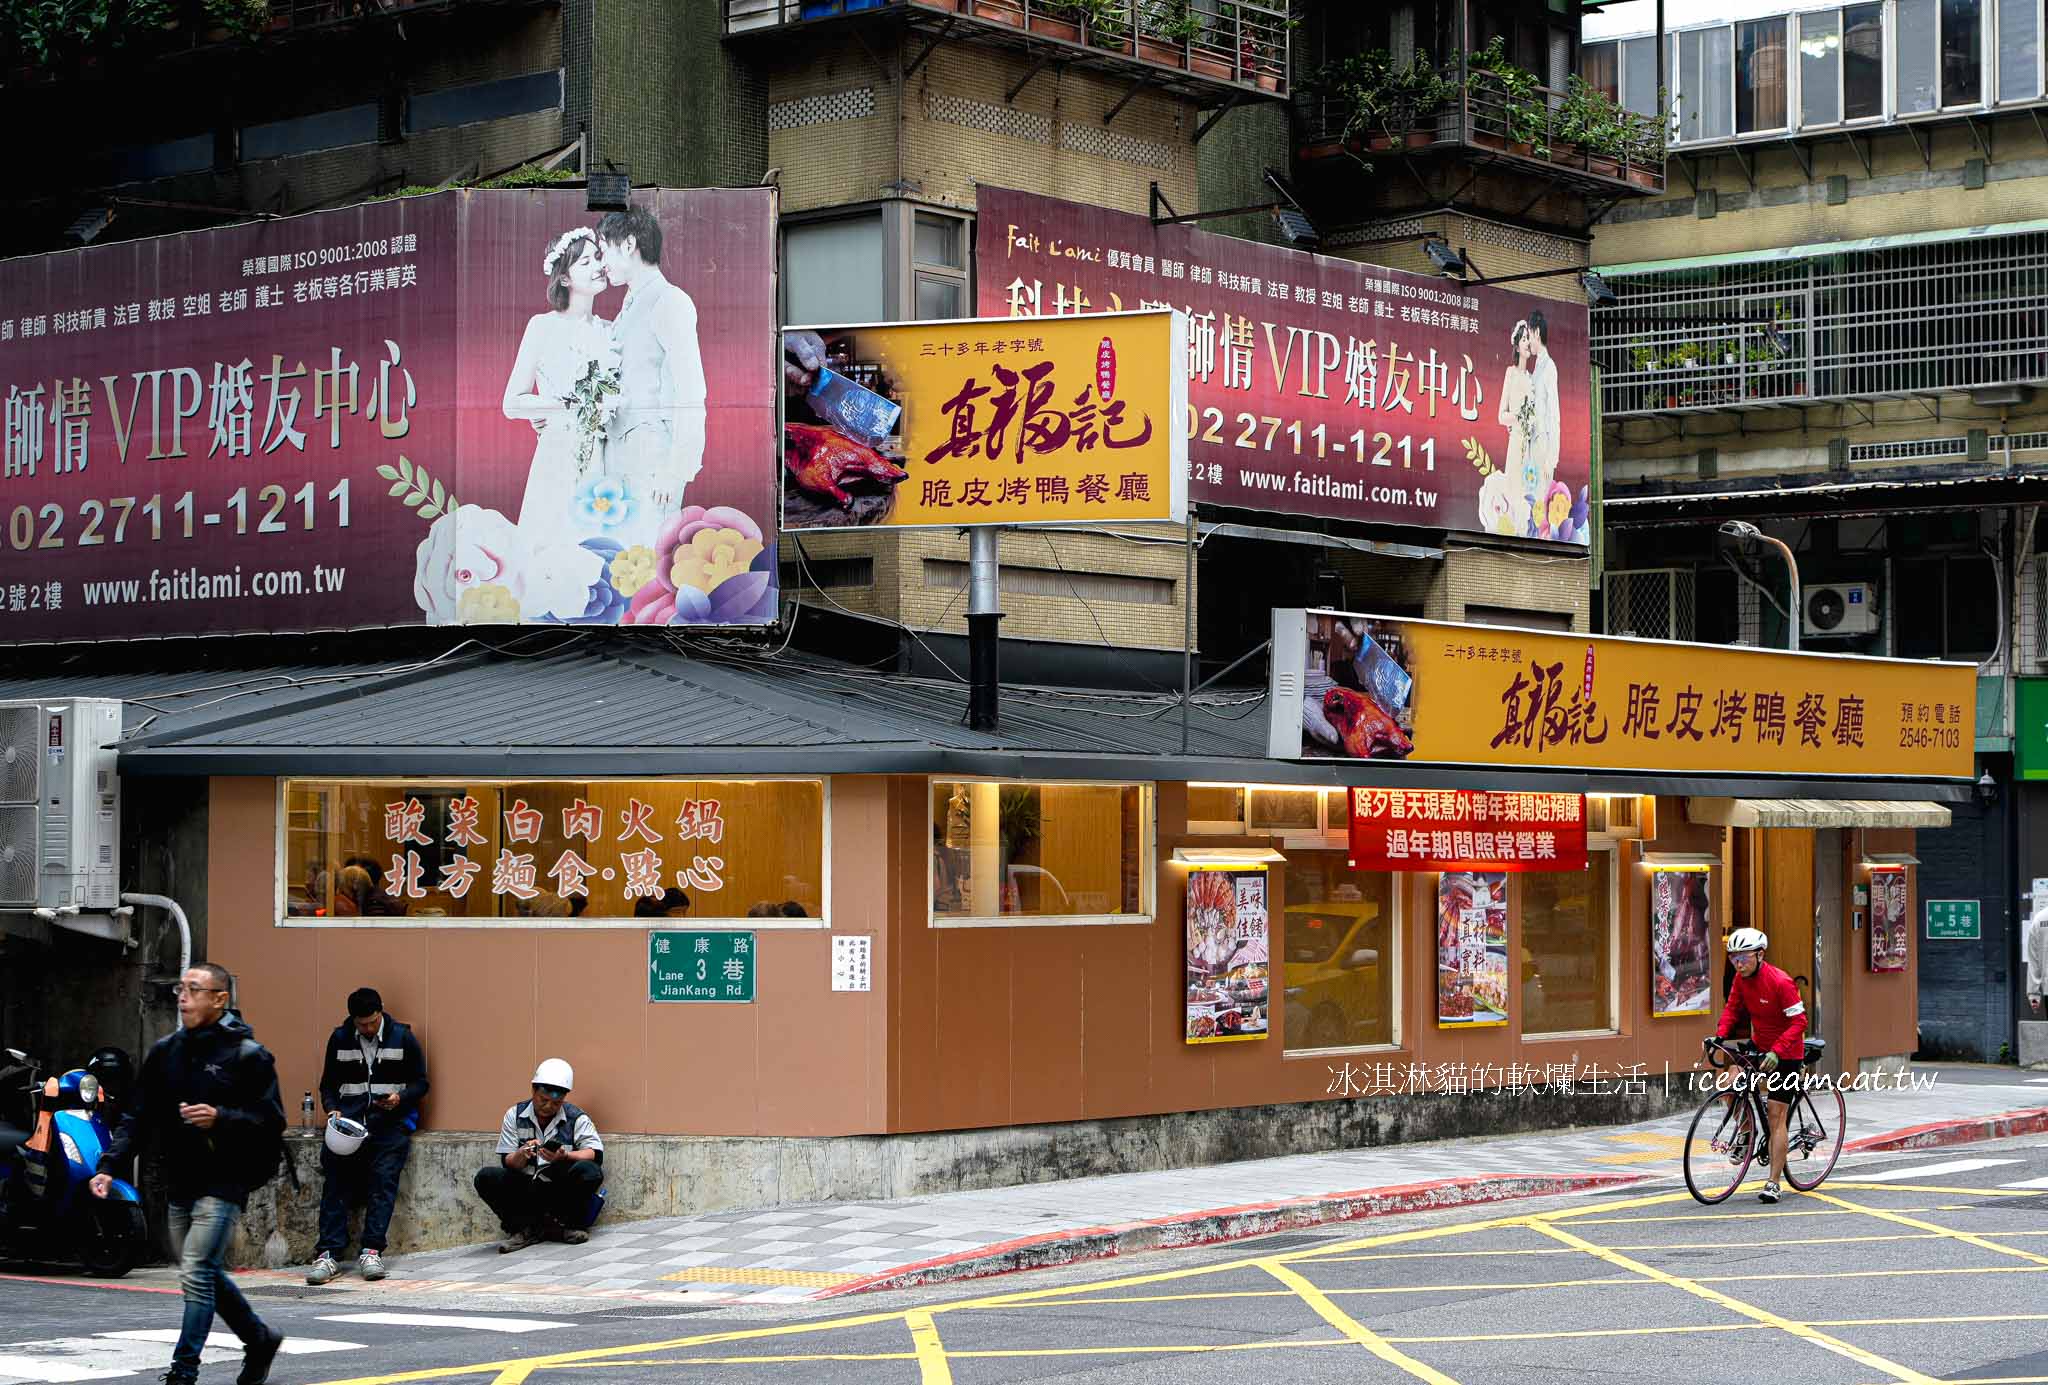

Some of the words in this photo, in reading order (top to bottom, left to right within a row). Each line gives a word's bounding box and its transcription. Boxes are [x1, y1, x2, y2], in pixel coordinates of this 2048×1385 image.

[242, 254, 292, 277] 榮獲國際
[294, 250, 317, 270] ISO
[319, 239, 388, 265] 9001:2008
[391, 234, 417, 255] 認證
[0, 319, 14, 341] 師
[20, 315, 46, 339] 律師
[53, 307, 106, 334] 科技新貴
[113, 303, 141, 326] 法官
[148, 297, 175, 322] 教授
[183, 293, 211, 317] 空姐
[219, 288, 247, 313] 老師
[255, 284, 284, 308] 護士
[293, 264, 417, 303] 老板等各行業菁英
[1107, 249, 1156, 275] 優質會員
[1161, 258, 1185, 281] 醫師
[1190, 263, 1212, 285] 律師
[1217, 270, 1262, 296] 科技新貴
[1267, 280, 1289, 300] 法官
[1294, 286, 1316, 306] 教授
[1321, 291, 1343, 310] 空姐
[1348, 295, 1369, 315] 老師
[1374, 300, 1395, 319] 護士
[1400, 305, 1479, 334] 老板等各行業菁英
[1365, 278, 1400, 297] 榮獲國際
[1401, 284, 1417, 299] ISO
[1418, 288, 1461, 306] 9001:2008
[1463, 296, 1479, 312] 認證
[919, 338, 1045, 357] 三十多年老字號
[925, 361, 1152, 465] 真福記
[1187, 403, 1224, 444] 02
[1234, 412, 1435, 472] 2711-1211
[919, 472, 1151, 508] 脆皮烤鴨餐廳
[1240, 469, 1438, 508] www.faitlami.com.tw
[9, 503, 65, 551] 02
[78, 478, 350, 547] 2711-1211
[83, 564, 346, 606] www.faitlami.com.tw
[1444, 644, 1522, 664] 三十多年老字號
[1490, 660, 1608, 752] 真福記
[1623, 682, 1865, 749] 脆皮烤鴨餐廳
[1900, 703, 1961, 724] 預約電話
[1900, 727, 1960, 748] 2546-7103
[384, 796, 725, 847] 酸菜白肉火鍋
[1355, 789, 1580, 823] 除夕當天現煮外帶年菜開始預購
[1386, 829, 1556, 860] 過年期間照常營業
[1949, 914, 1956, 927] 5
[655, 937, 749, 954] 健康路
[659, 970, 684, 981] Lane
[696, 958, 707, 981] 3
[722, 958, 745, 981] 巷
[660, 985, 717, 998] JianKang
[726, 984, 745, 996] Rd.
